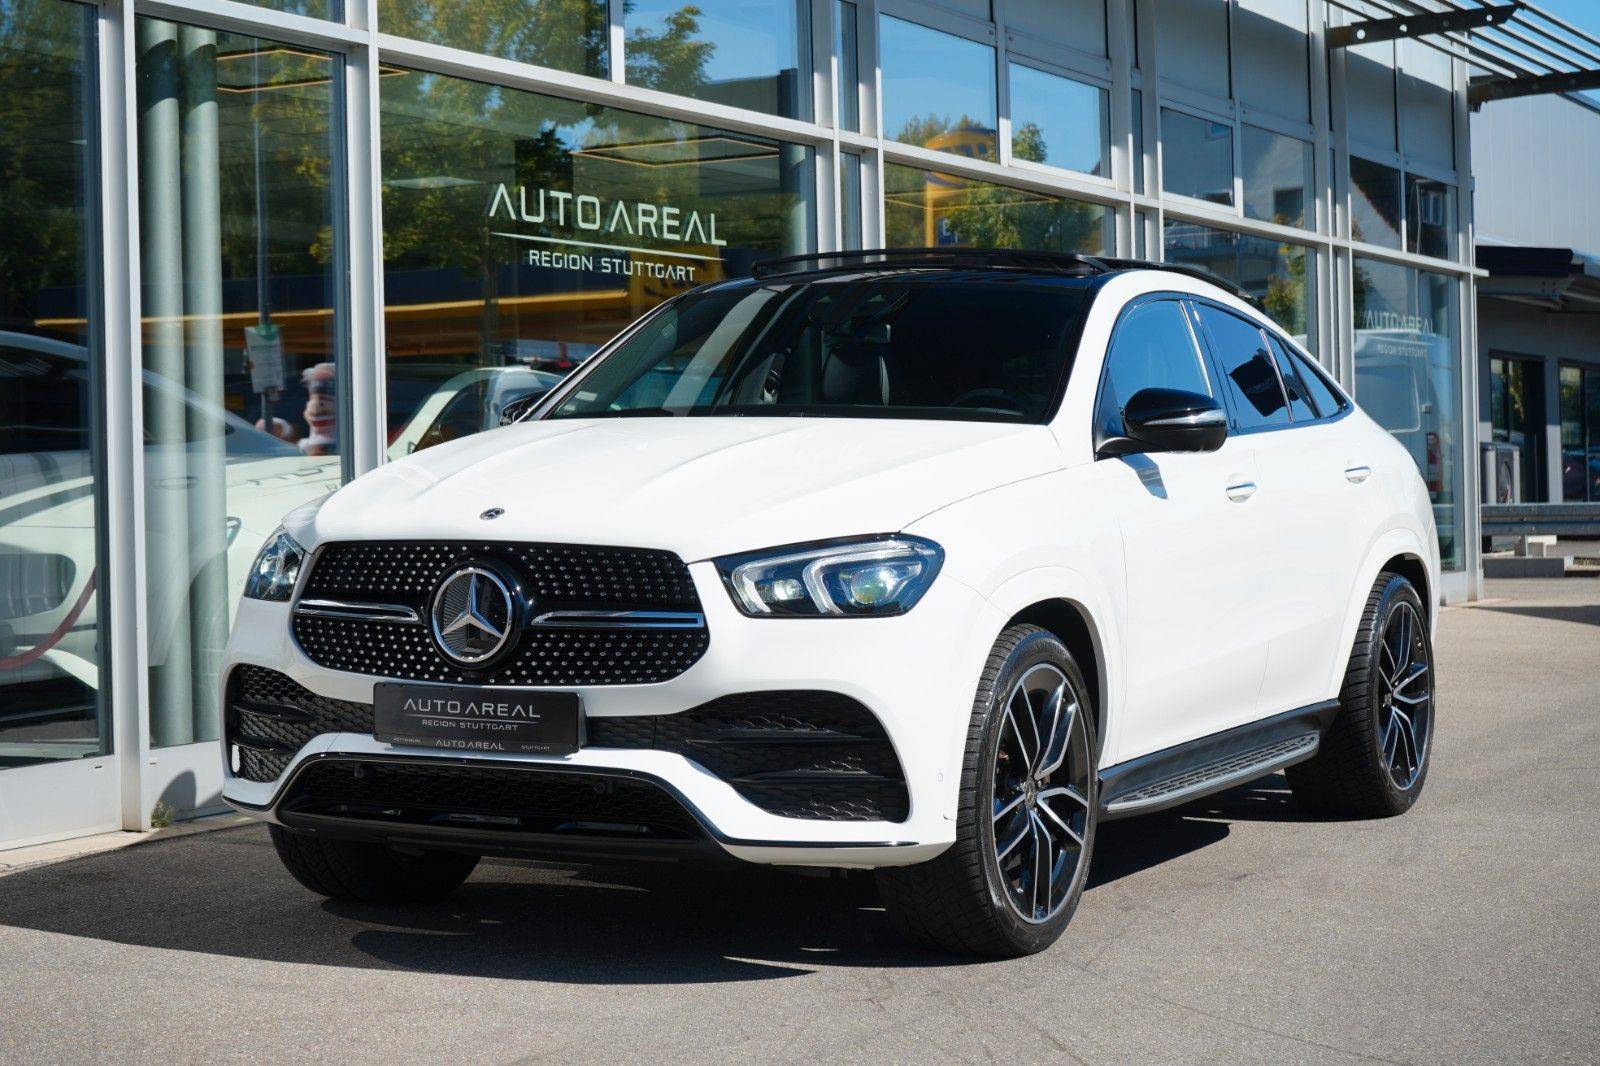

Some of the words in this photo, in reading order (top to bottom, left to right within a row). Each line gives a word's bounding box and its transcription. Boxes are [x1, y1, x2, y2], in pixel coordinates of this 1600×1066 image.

[529, 249, 593, 271] REGION
[601, 258, 696, 281] STUTTGART
[421, 719, 456, 728] REGION
[459, 721, 519, 731] STUTTGART
